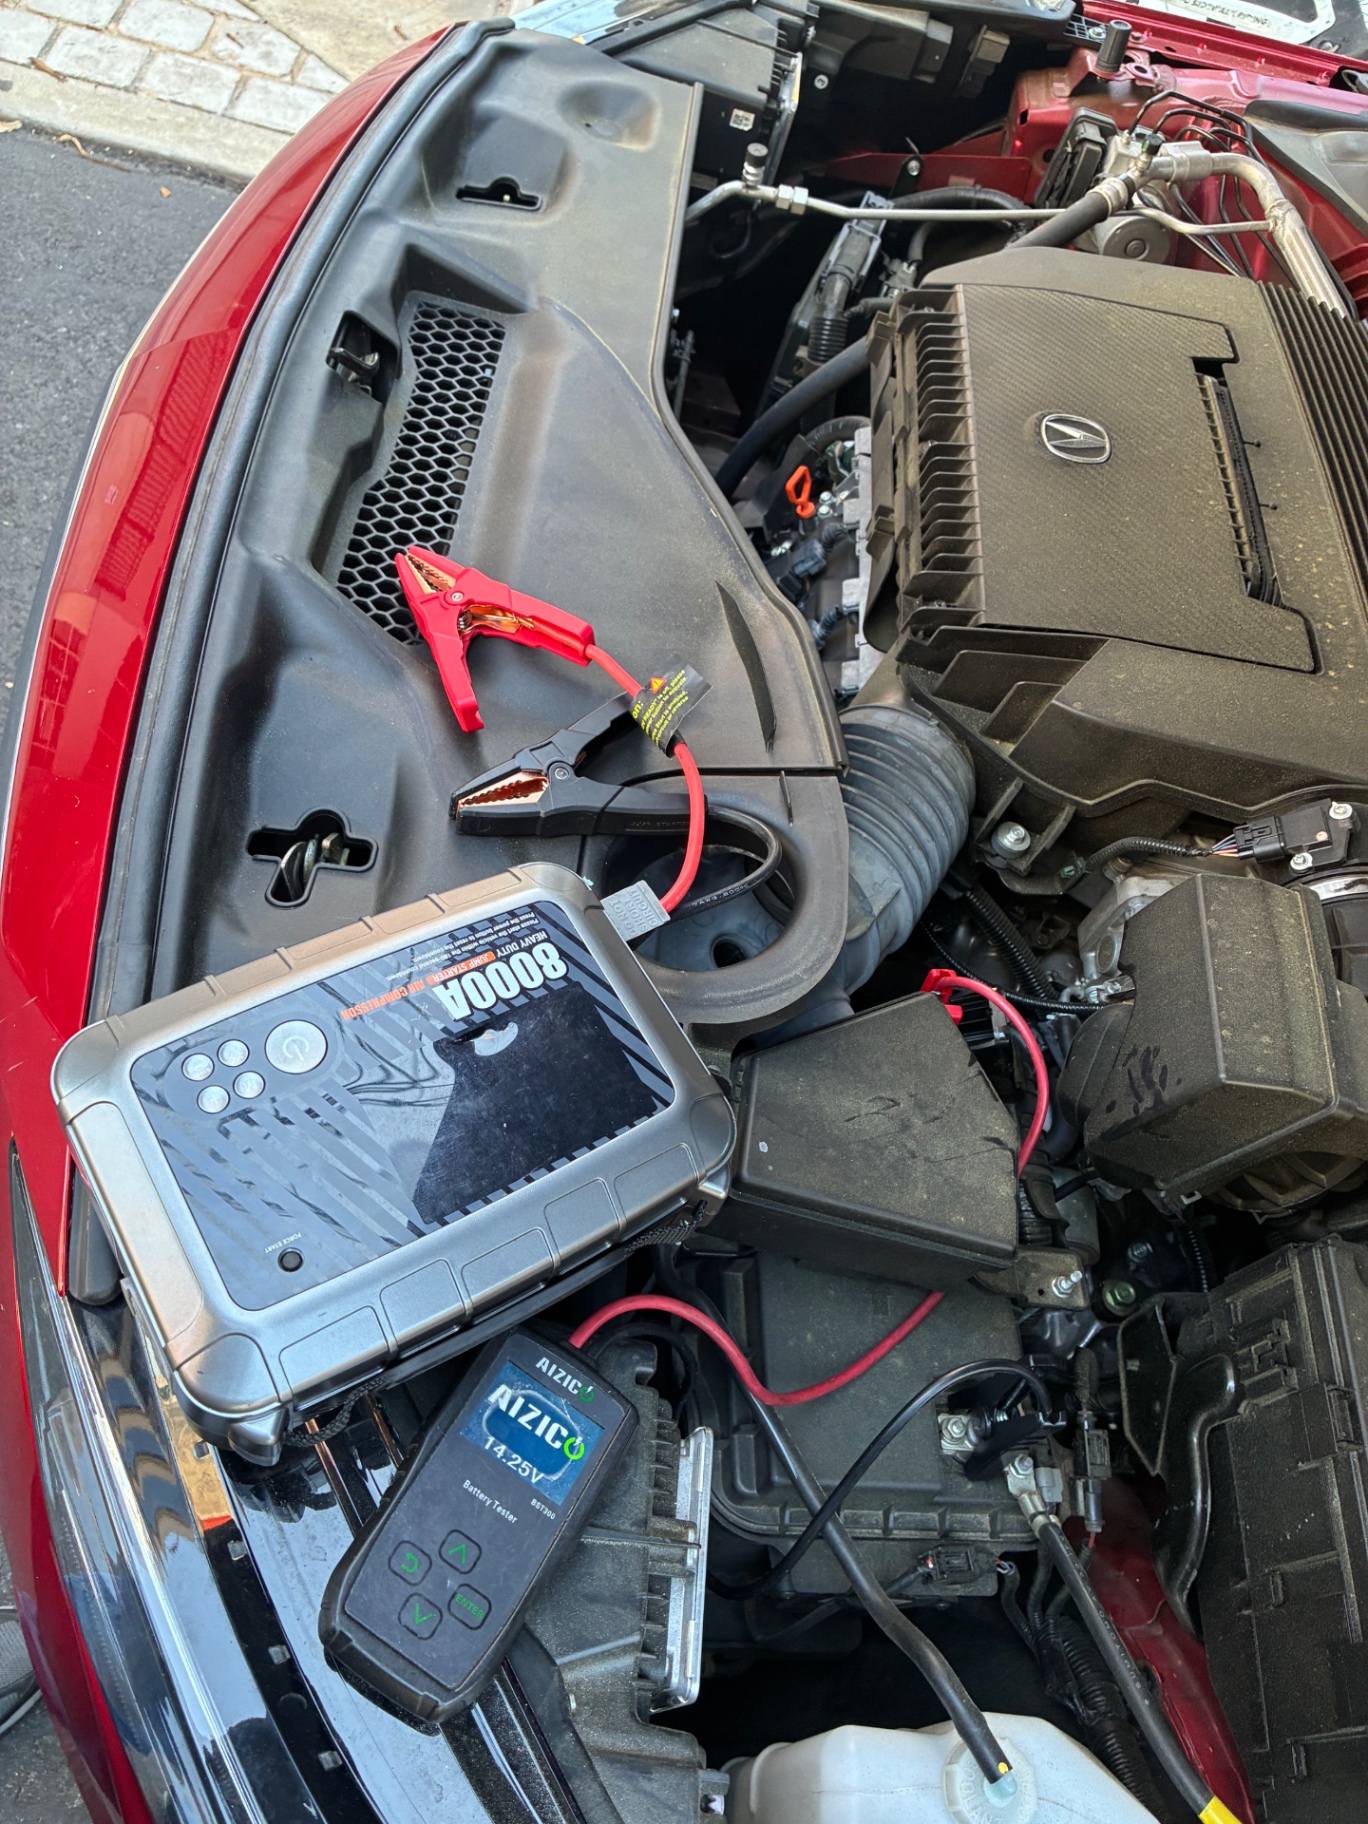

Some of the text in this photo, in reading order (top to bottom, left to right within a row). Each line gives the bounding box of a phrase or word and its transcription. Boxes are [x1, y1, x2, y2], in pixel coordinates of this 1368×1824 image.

[670, 670, 685, 687] please
[672, 696, 688, 713] reverse
[655, 715, 666, 728] Start
[518, 911, 534, 922] Press
[608, 897, 628, 921] NOT
[621, 896, 648, 932] SHORT
[492, 919, 509, 931] power
[507, 924, 521, 935] start
[509, 917, 519, 926] the
[520, 917, 538, 929] Please
[474, 927, 493, 939] button
[478, 933, 498, 946] vehicle
[498, 930, 508, 938] the
[453, 937, 468, 948] reset
[460, 941, 479, 953] within
[451, 948, 461, 956] the
[340, 929, 547, 1020] HEAVY DUTY JUMP STARTER AIR COMPRESSOR
[385, 965, 418, 981] countdown.
[432, 942, 567, 1020] 8000A
[263, 1231, 301, 1253] FORCE START
[484, 1437, 545, 1484] 14.25V
[462, 1479, 518, 1523] Battery Tester
[530, 1498, 556, 1520] BST300
[455, 1594, 485, 1622] ENTER
[1097, 1608, 1142, 1689] SUMITOMO
